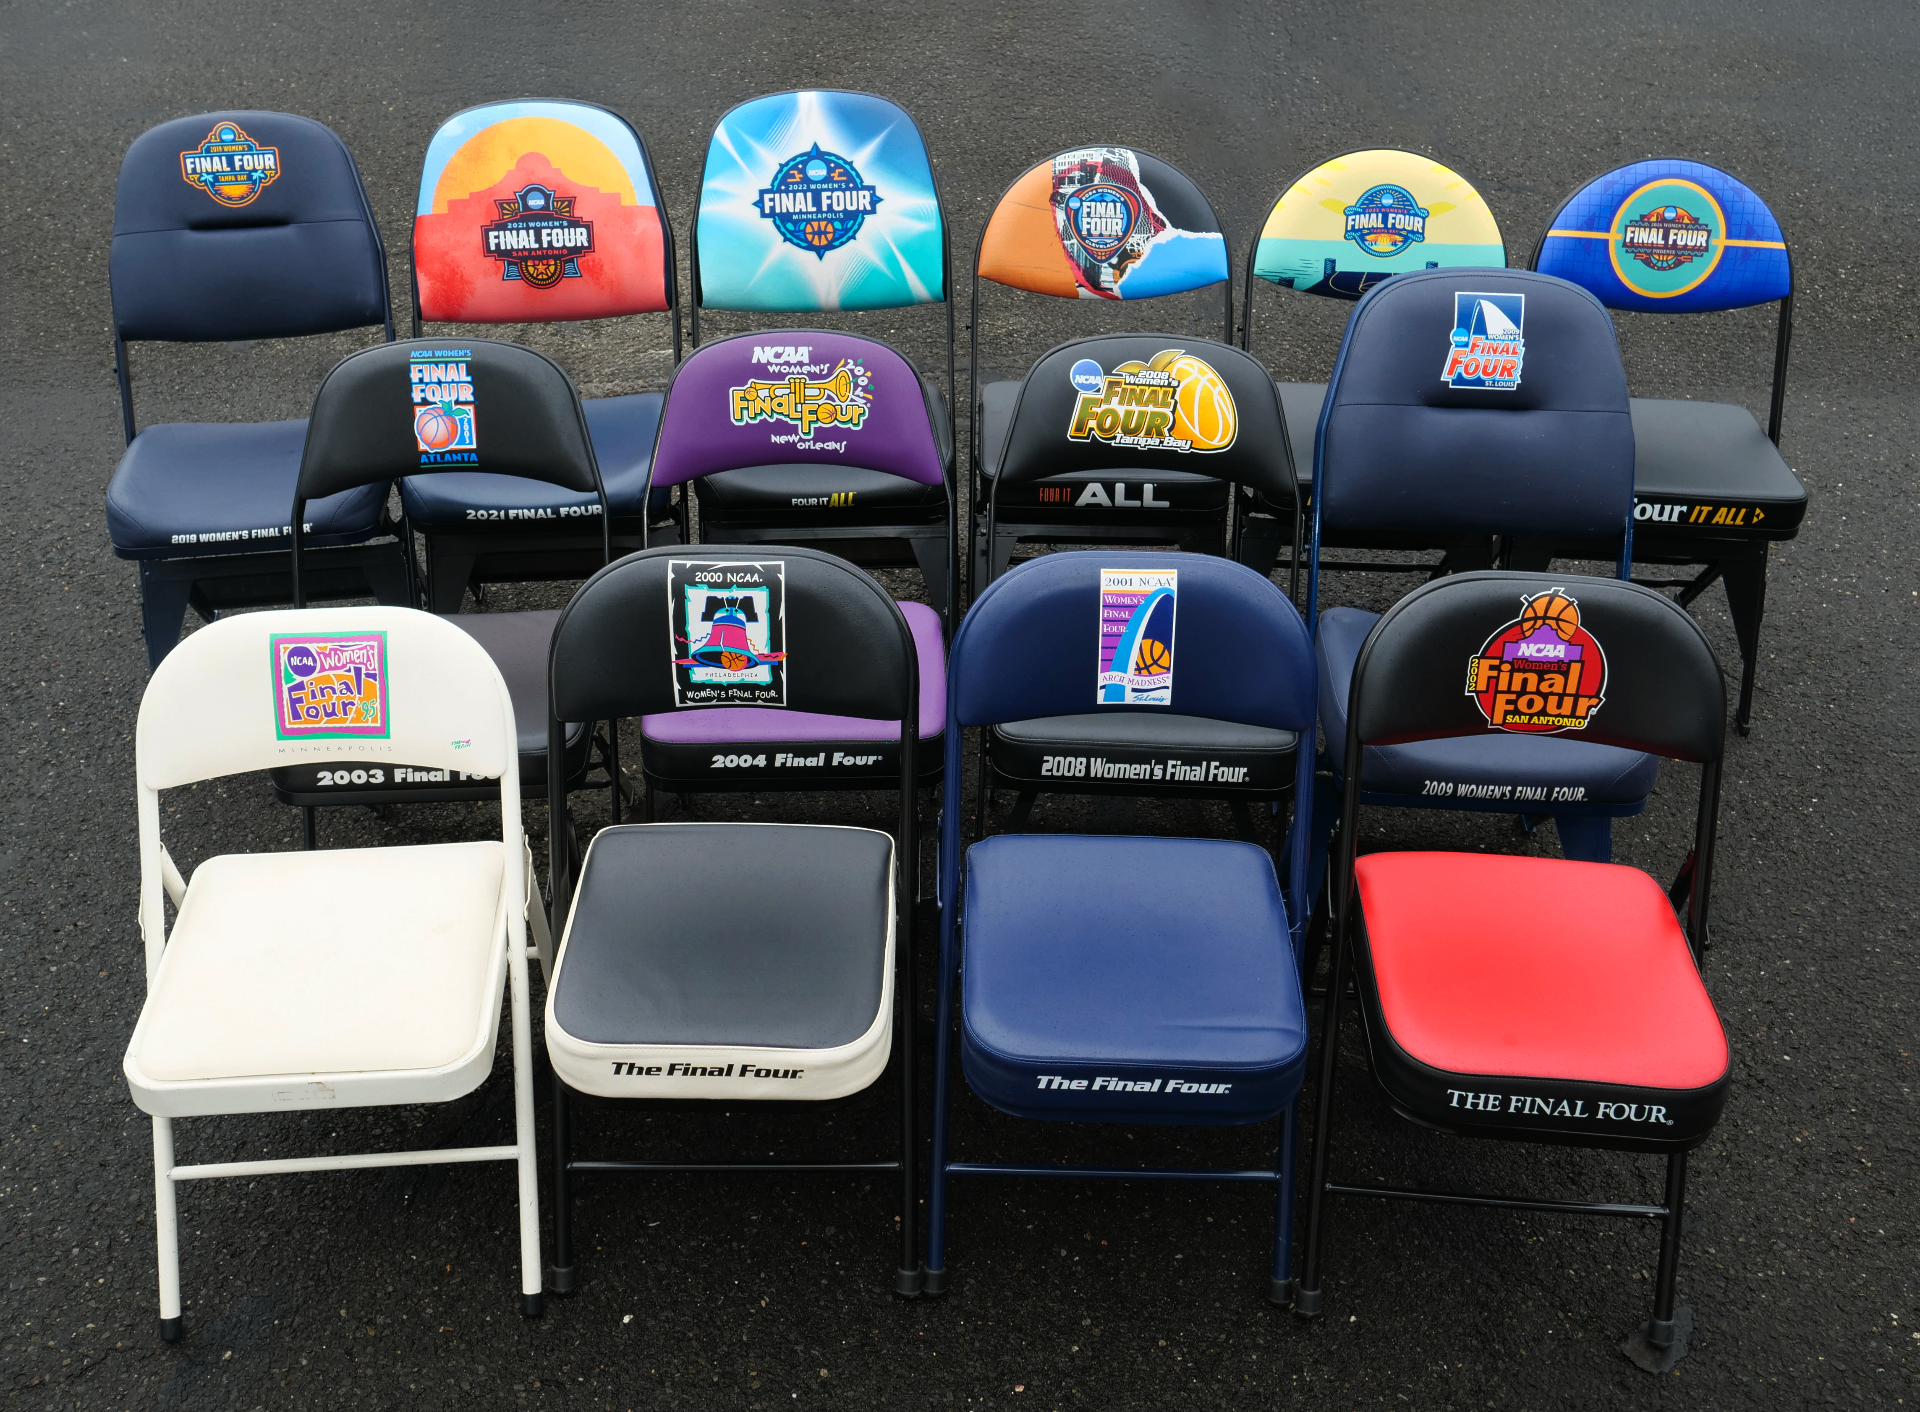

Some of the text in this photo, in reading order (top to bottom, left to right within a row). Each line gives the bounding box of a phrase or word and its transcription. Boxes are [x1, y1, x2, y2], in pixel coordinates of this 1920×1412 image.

[186, 154, 276, 174] FINAL FOUR
[764, 191, 871, 214] FINAL FOUR
[1082, 202, 1124, 218] FINAL
[1082, 218, 1123, 236] FOUR
[1348, 213, 1423, 233] FINAL FOUR
[489, 228, 589, 251] FINAL FOUR
[1086, 240, 1119, 249] CLEVELAND
[1626, 227, 1708, 247] FINAL FOUR
[752, 347, 809, 363] NCAA
[1469, 337, 1519, 356] FINAL
[410, 363, 472, 383] FINAL
[1447, 350, 1518, 378] FOUR
[1075, 375, 1102, 384] NCAA
[1125, 375, 1179, 387] Women's
[1138, 370, 1169, 379] 2008
[412, 383, 475, 403] FOUR
[1102, 378, 1175, 408] FINAL
[1071, 396, 1170, 438] FOUR
[1115, 434, 1192, 450] Tampa Bay
[421, 453, 478, 463] ATLANTA
[792, 492, 857, 508] FOUR IT ALL
[1040, 483, 1170, 508] FOUR IT ALL
[466, 505, 603, 520] 2021 FINAL FOUR
[1634, 498, 1747, 525] our IT ALL
[172, 524, 311, 544] 2019 WOMEN'S FINAL FR
[695, 572, 759, 583] 2000 NCAA
[1105, 577, 1171, 587] 2001 NCAA
[1104, 595, 1145, 605] WOMEN'S
[1104, 610, 1130, 619] FINAL
[1103, 624, 1126, 633] FOUR
[291, 646, 375, 670] NCAA Women's
[1518, 644, 1565, 658] NCAA
[1514, 660, 1568, 671] Women's
[1102, 675, 1167, 687] ARCH MADNESS
[1469, 659, 1479, 691] 2002
[1476, 659, 1582, 694] Final
[287, 665, 363, 721] Final
[287, 680, 376, 721] Four '95
[687, 689, 776, 699] WOMEN'S FINAL FOUR
[1493, 694, 1600, 725] Four
[1506, 715, 1585, 727] SAN ANTONIO
[710, 752, 877, 768] 2004 Final Four
[317, 769, 385, 786] 2003
[394, 768, 450, 783] Final
[1041, 756, 1248, 783] 2008 Women's Final Four
[1422, 780, 1585, 802] 2009 WOMEN'S FINAL FOUR
[612, 1062, 804, 1079] The Final Four
[1037, 1076, 1232, 1094] The Final Four
[1447, 1089, 1667, 1123] THE FINAL FOUR
